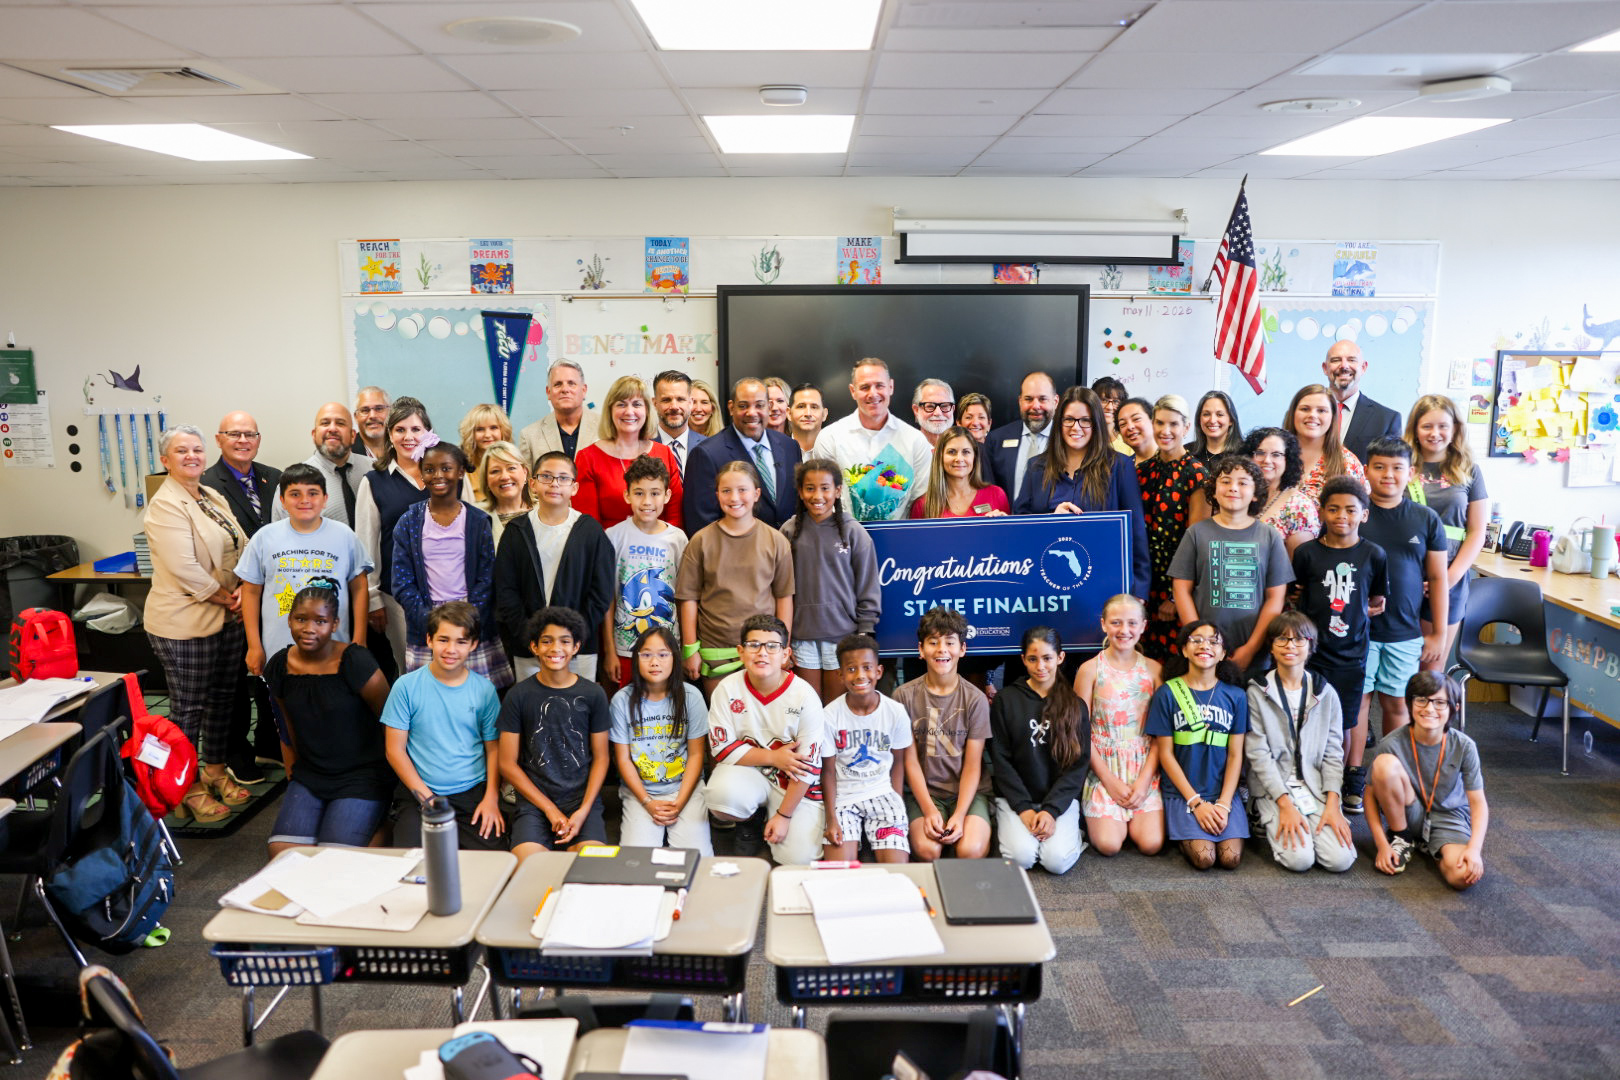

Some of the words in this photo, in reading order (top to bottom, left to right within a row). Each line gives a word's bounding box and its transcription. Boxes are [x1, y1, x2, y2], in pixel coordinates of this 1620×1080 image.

[360, 241, 390, 252] REACH
[651, 239, 672, 247] TODAY
[847, 237, 873, 247] MAKE
[1344, 241, 1357, 249] YOU
[375, 251, 387, 259] FOR
[473, 249, 510, 259] DREAMS
[656, 247, 688, 255] ANOTHER
[842, 247, 878, 259] WAVES
[645, 255, 670, 263] CHANCE
[672, 255, 680, 263] TO
[494, 319, 510, 360] FGCU
[565, 333, 713, 355] BENCHMARK
[272, 549, 309, 560] REACHING
[326, 552, 340, 562] THE
[628, 545, 667, 558] SONIC
[878, 553, 1034, 595] Congratulations
[1040, 568, 1061, 590] TEACHER
[1072, 580, 1084, 589] THE
[1082, 565, 1093, 581] YEAR
[903, 598, 966, 617] STATE
[973, 594, 1072, 615] FINALIST
[1550, 627, 1620, 681] CAMPB
